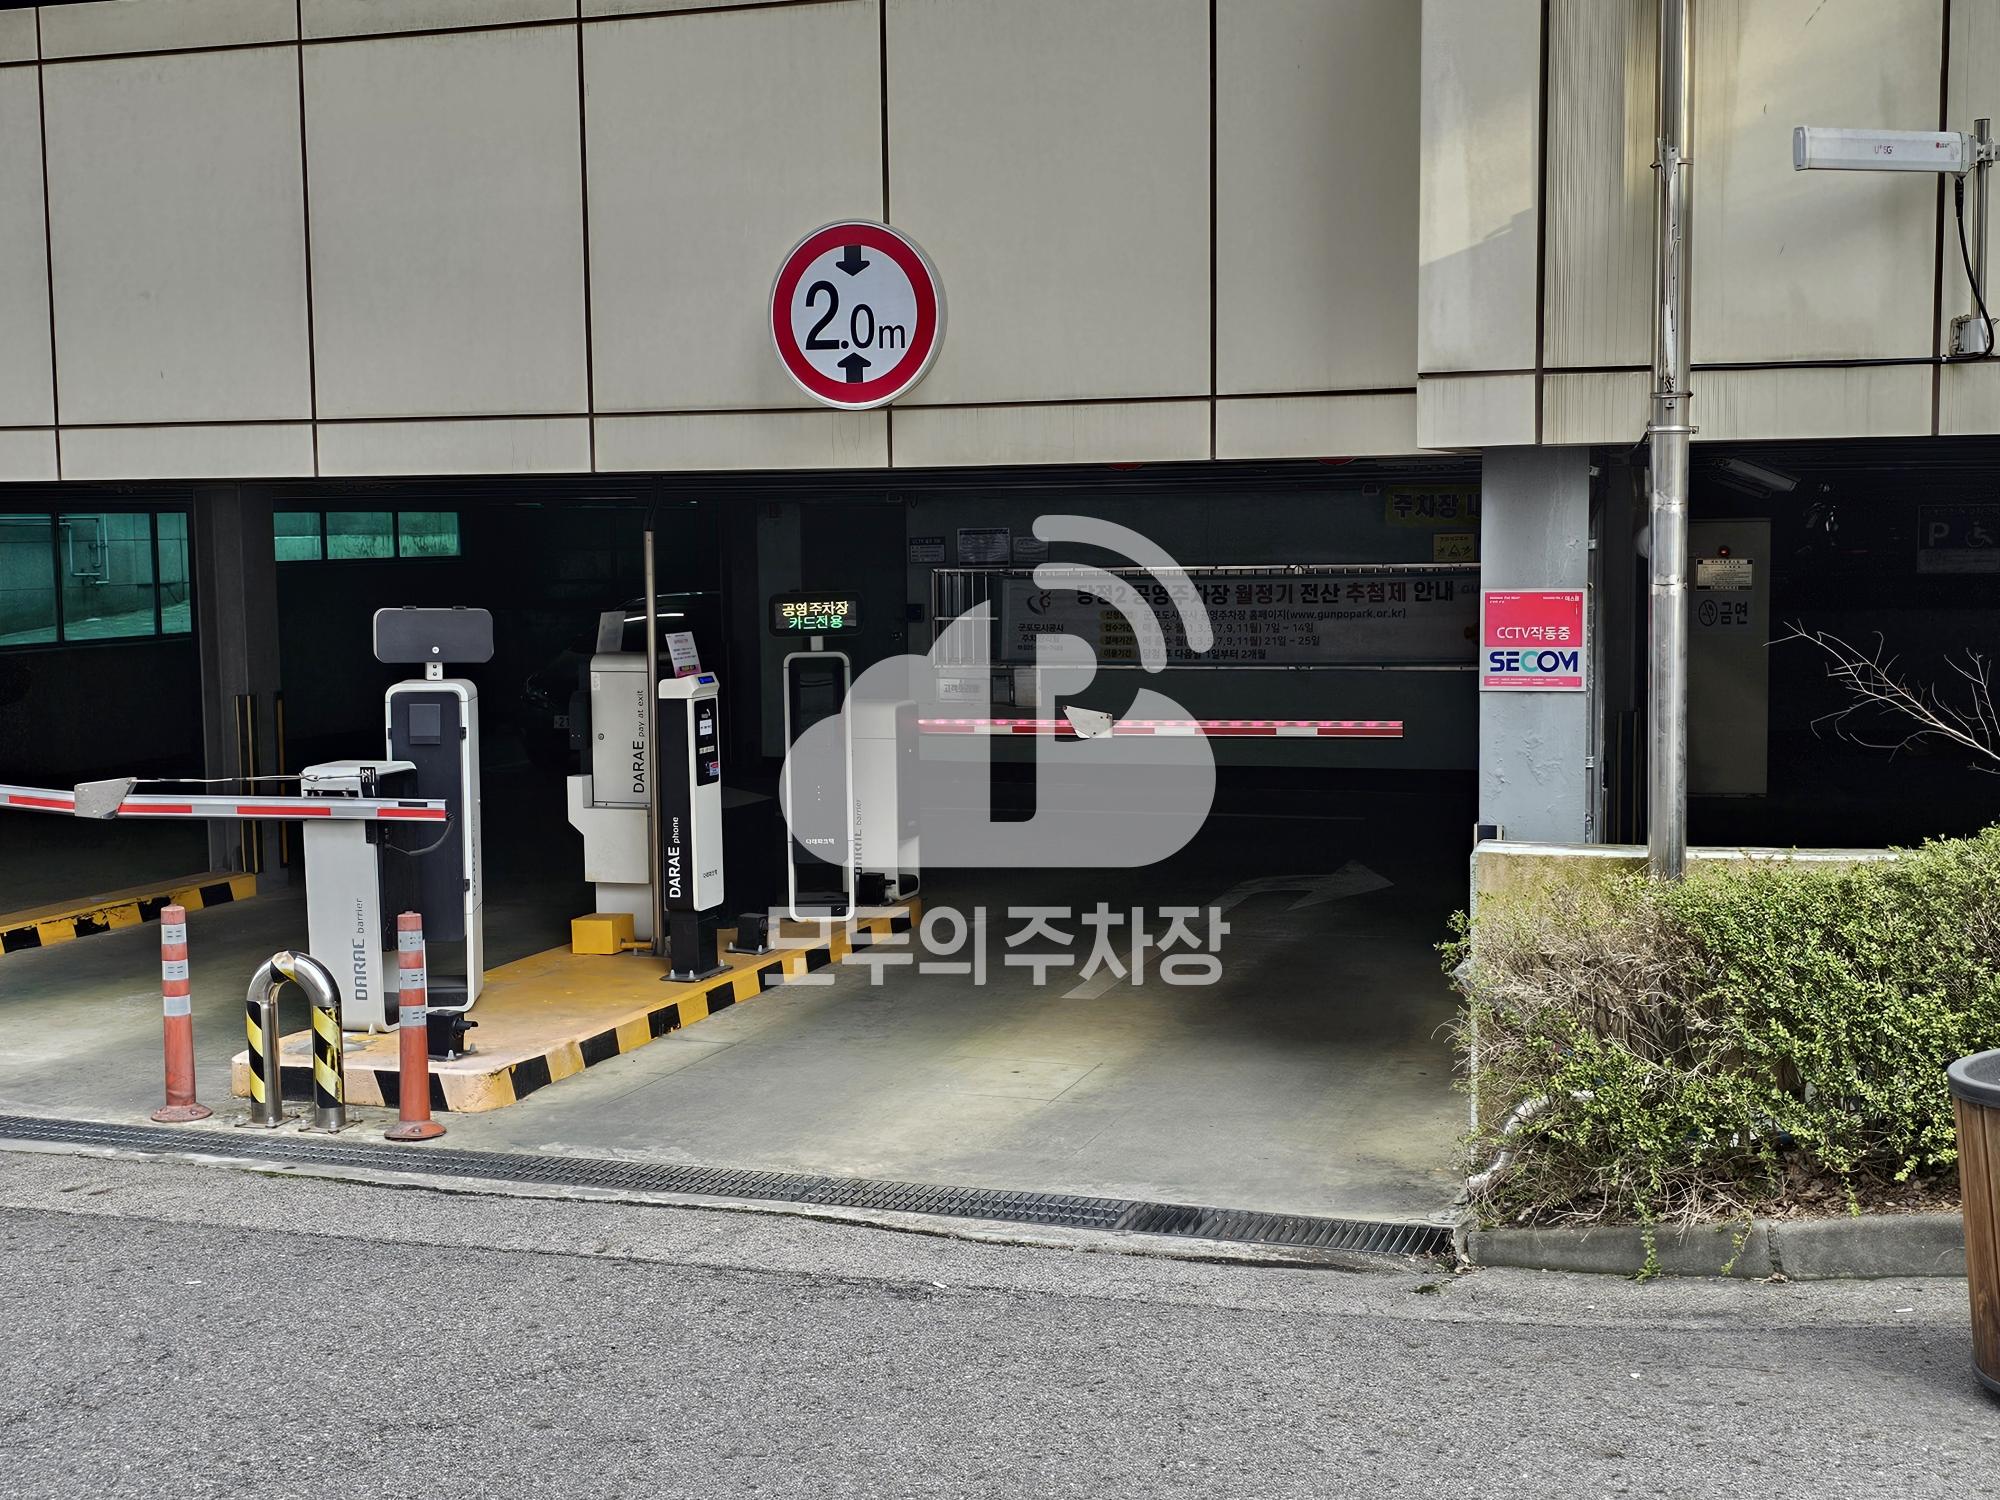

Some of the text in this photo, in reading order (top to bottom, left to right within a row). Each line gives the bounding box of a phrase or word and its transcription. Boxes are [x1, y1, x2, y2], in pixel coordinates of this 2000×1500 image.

[805, 280, 906, 350] 2.0m
[1393, 493, 1459, 519] 주차장
[1928, 521, 1950, 547] P
[1132, 583, 1230, 606] 공영주차장
[1235, 582, 1293, 605] 월정기
[1300, 583, 1340, 604] 전산
[1346, 582, 1406, 604] 추첨제
[1413, 580, 1454, 602] 안내
[782, 600, 849, 617] 공영주차장
[1719, 601, 1748, 625] 금연
[788, 615, 843, 630] 카드전용
[1496, 626, 1571, 640] CCTV작동중
[1241, 648, 1267, 660] 2개월
[1489, 650, 1579, 673] SECOM
[638, 708, 644, 719] at
[633, 740, 645, 793] DARAE
[668, 816, 681, 898] DARAE phone
[352, 898, 368, 1001] DARAE barrier
